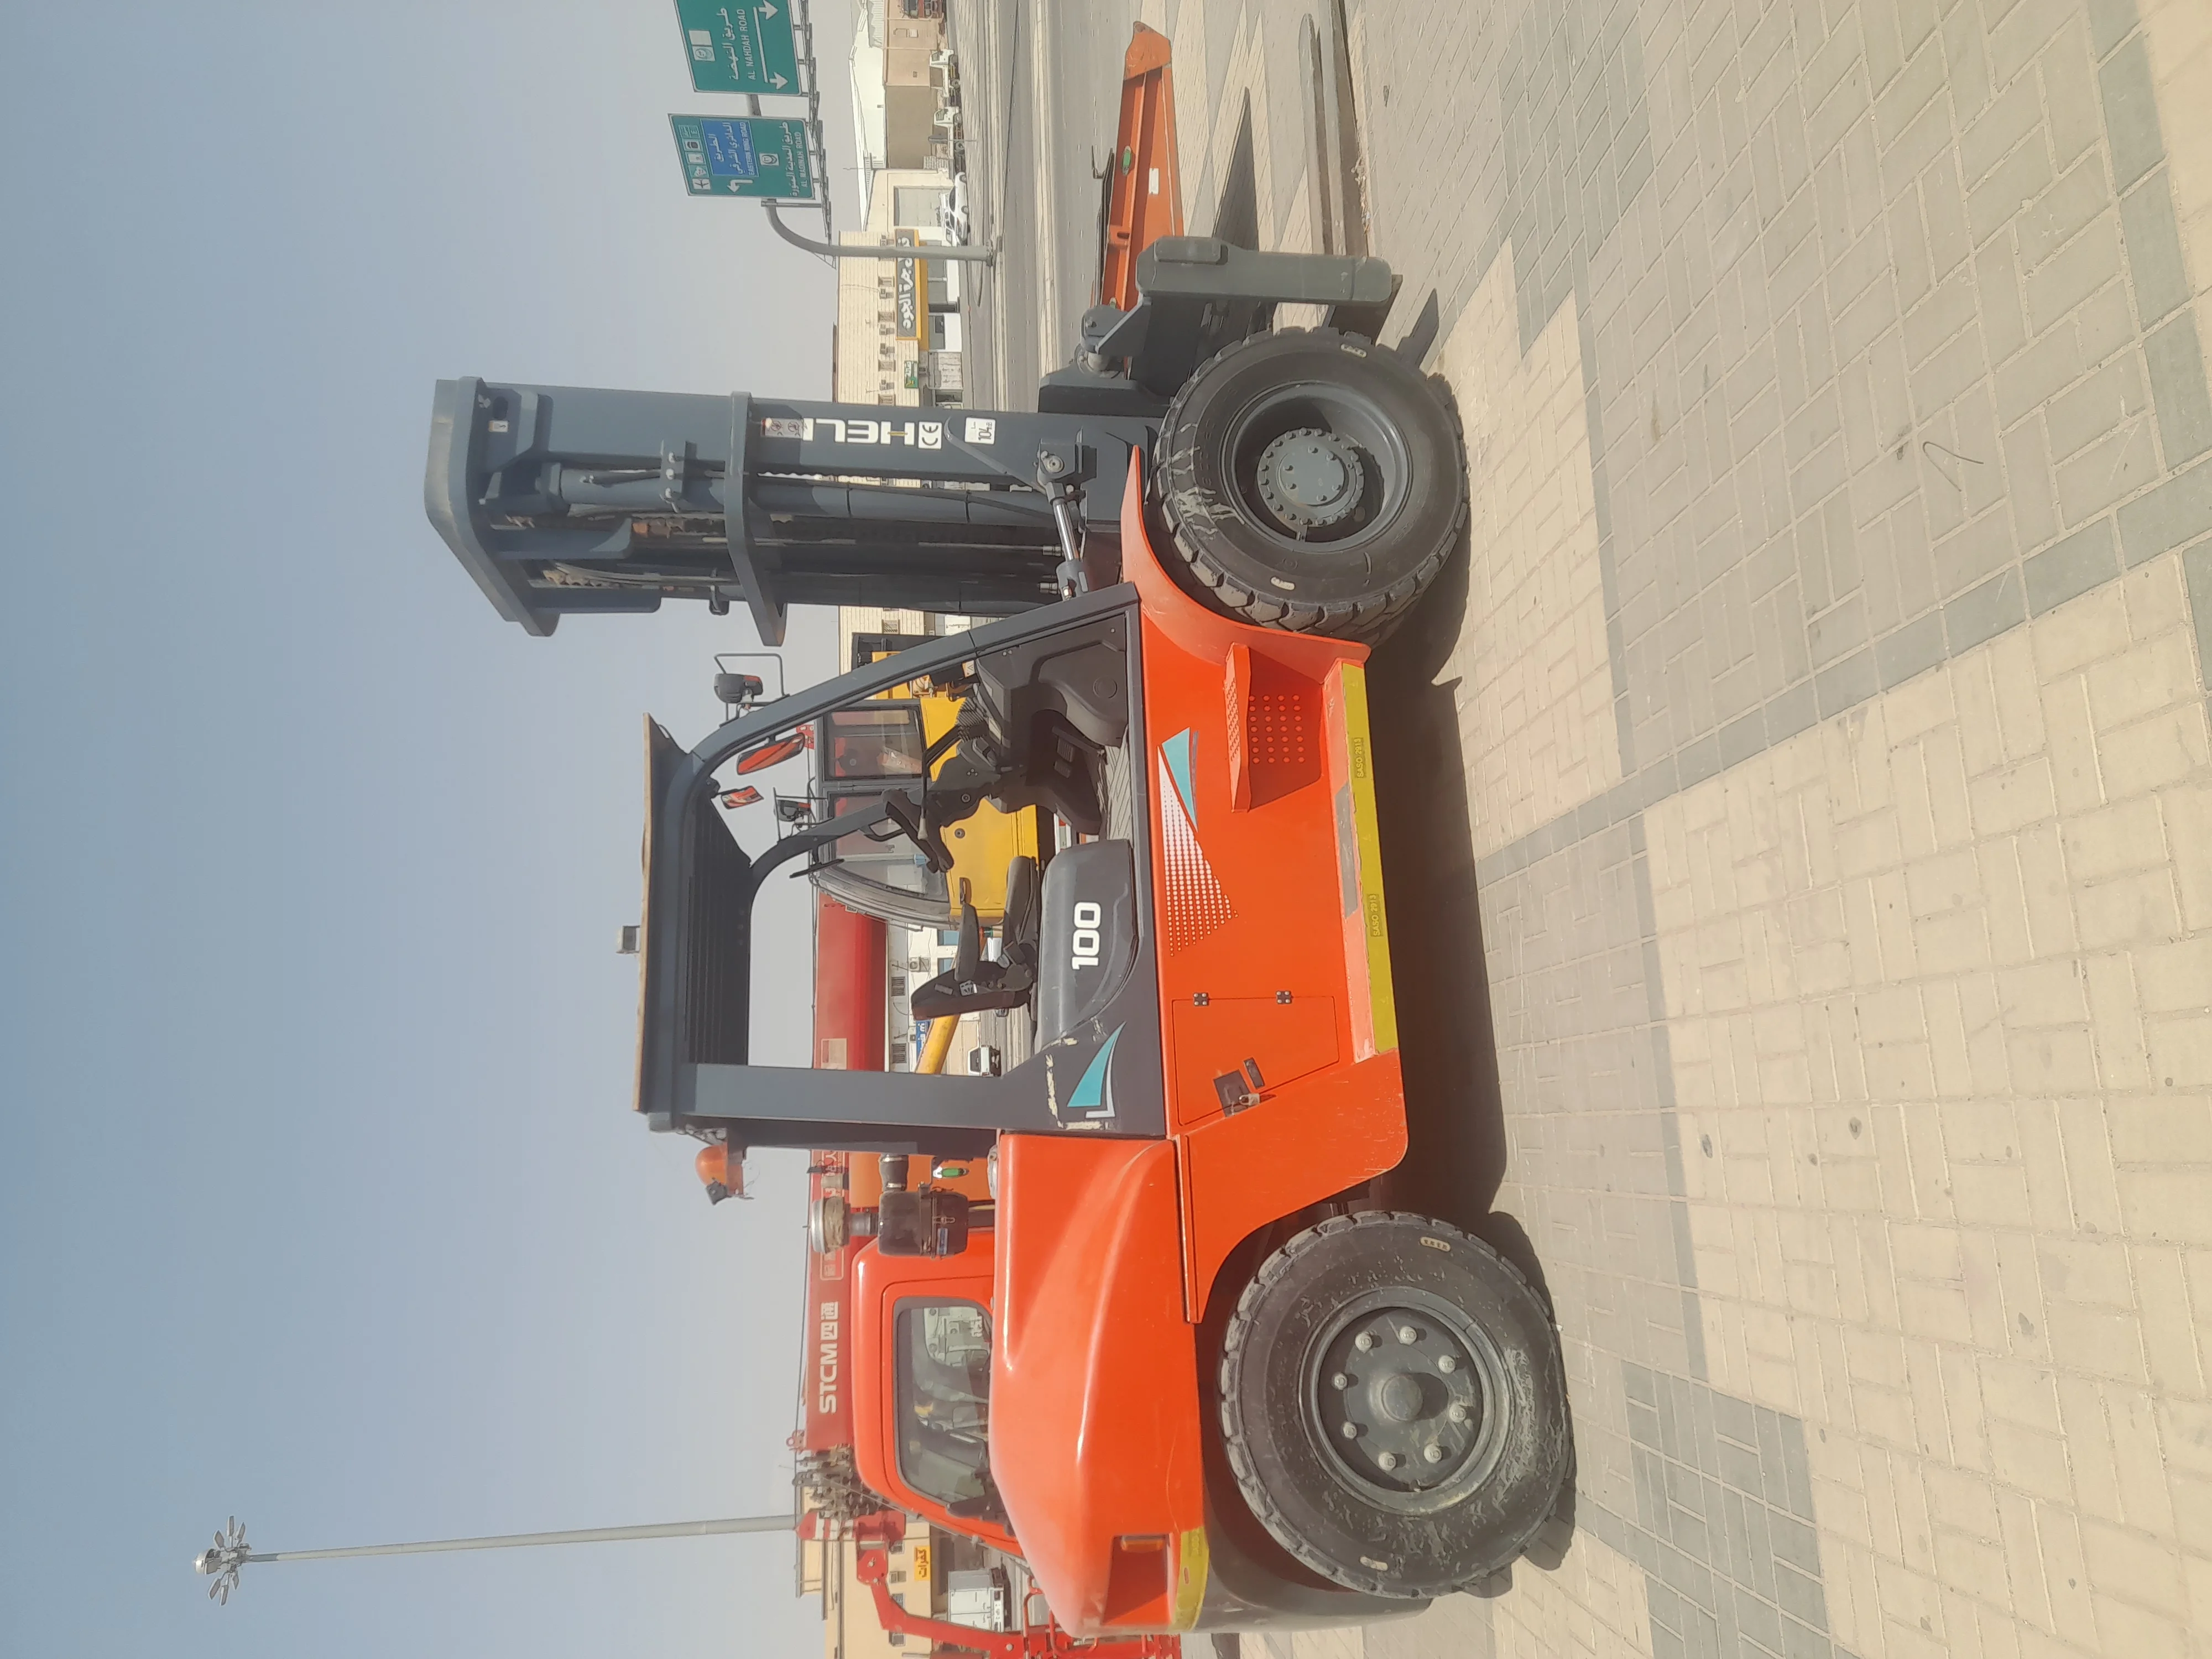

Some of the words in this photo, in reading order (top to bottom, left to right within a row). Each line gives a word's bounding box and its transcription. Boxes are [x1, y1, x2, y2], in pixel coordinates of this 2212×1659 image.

[716, 8, 735, 40] طريق
[737, 9, 748, 32] ROAD
[721, 43, 739, 80] النهضة
[740, 35, 754, 66] NAHDAH
[748, 70, 756, 80] AL
[722, 122, 739, 148] الدائري
[739, 122, 748, 137] ROAD
[779, 122, 794, 145] طريق
[794, 132, 802, 149] ROAD
[707, 134, 724, 162] الطريق
[781, 145, 796, 171] المدينة
[727, 149, 745, 174] الشرقي
[745, 151, 755, 175] EASTERN
[786, 172, 800, 196] المنورة
[898, 293, 915, 329] الجود
[802, 418, 915, 445] HELI
[921, 424, 939, 446] CE
[1355, 757, 1364, 778] SASO
[1072, 902, 1101, 970] 100
[1371, 914, 1381, 936] SASO
[819, 1344, 837, 1413] STCM
